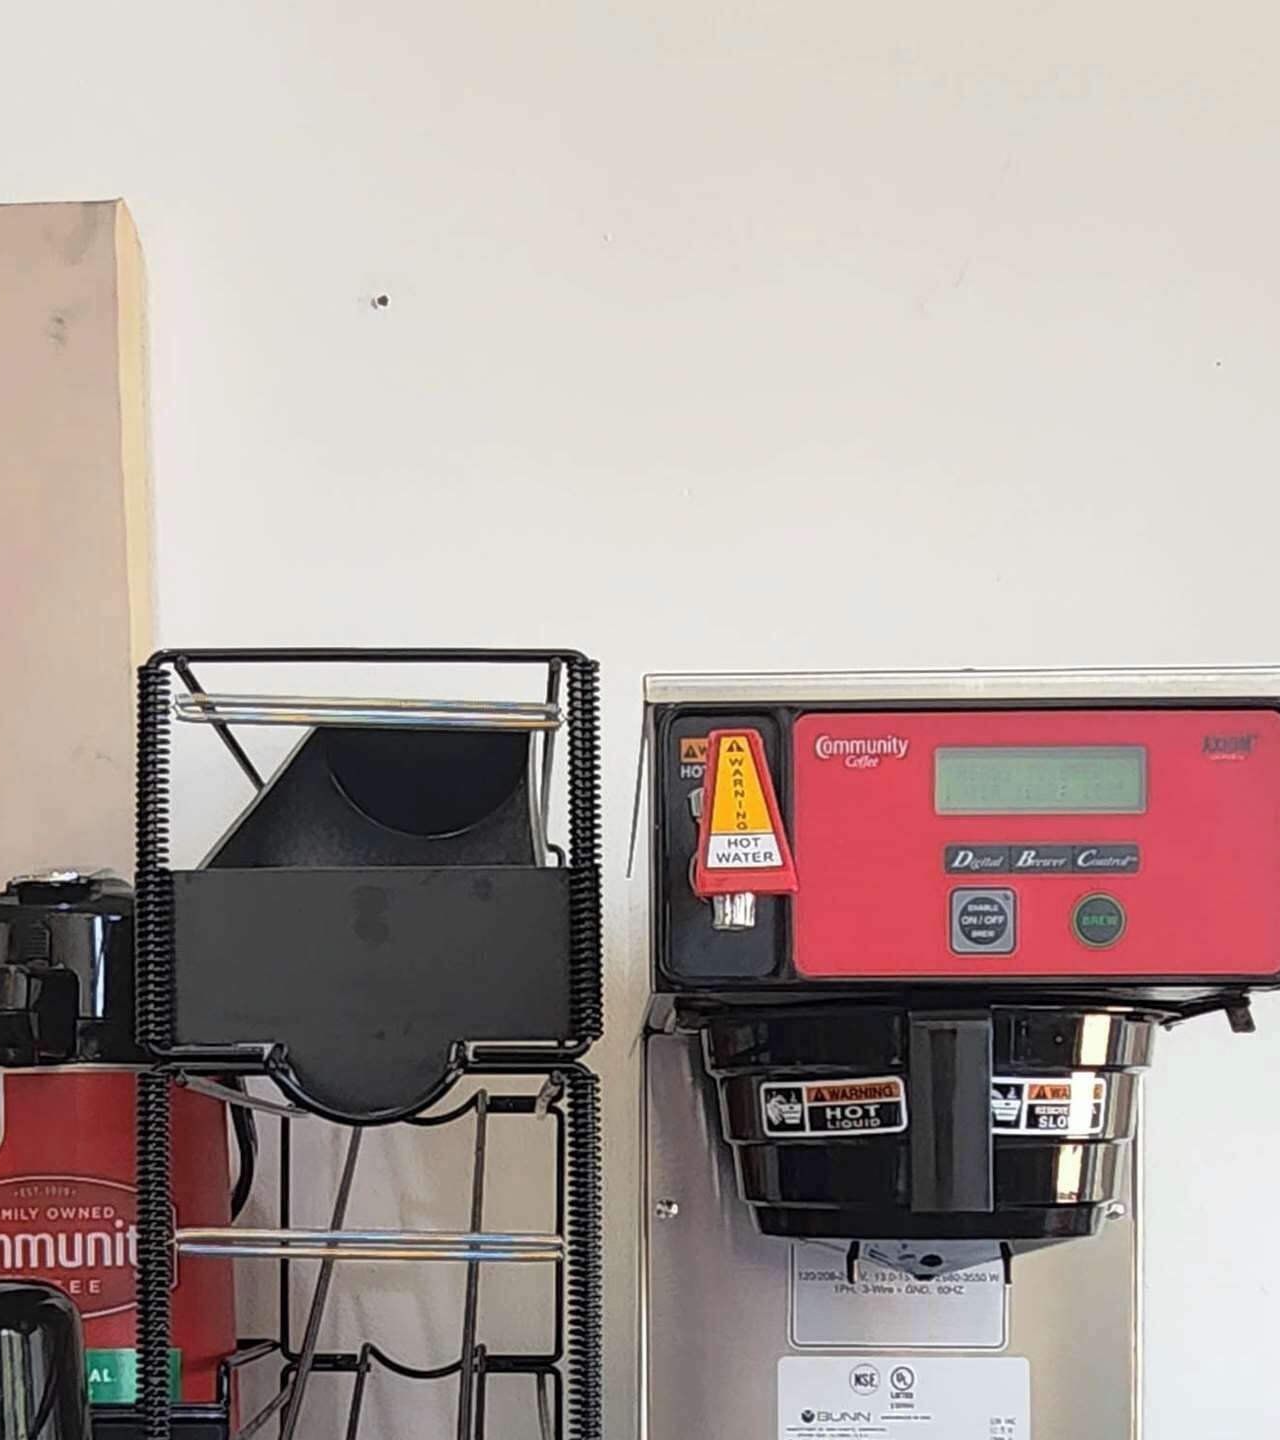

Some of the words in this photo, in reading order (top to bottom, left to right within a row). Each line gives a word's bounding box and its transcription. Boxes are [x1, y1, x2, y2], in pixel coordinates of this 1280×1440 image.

[815, 735, 908, 759] Community
[729, 757, 748, 830] WARNING
[727, 838, 761, 848] HOT
[716, 851, 774, 863] WATER
[1083, 916, 1118, 926] BREW
[829, 1086, 893, 1100] WARNING
[825, 1105, 881, 1120] HOT
[827, 1118, 881, 1129] LIQUID
[47, 1206, 115, 1221] OWNED
[817, 1411, 871, 1423] BUNN
